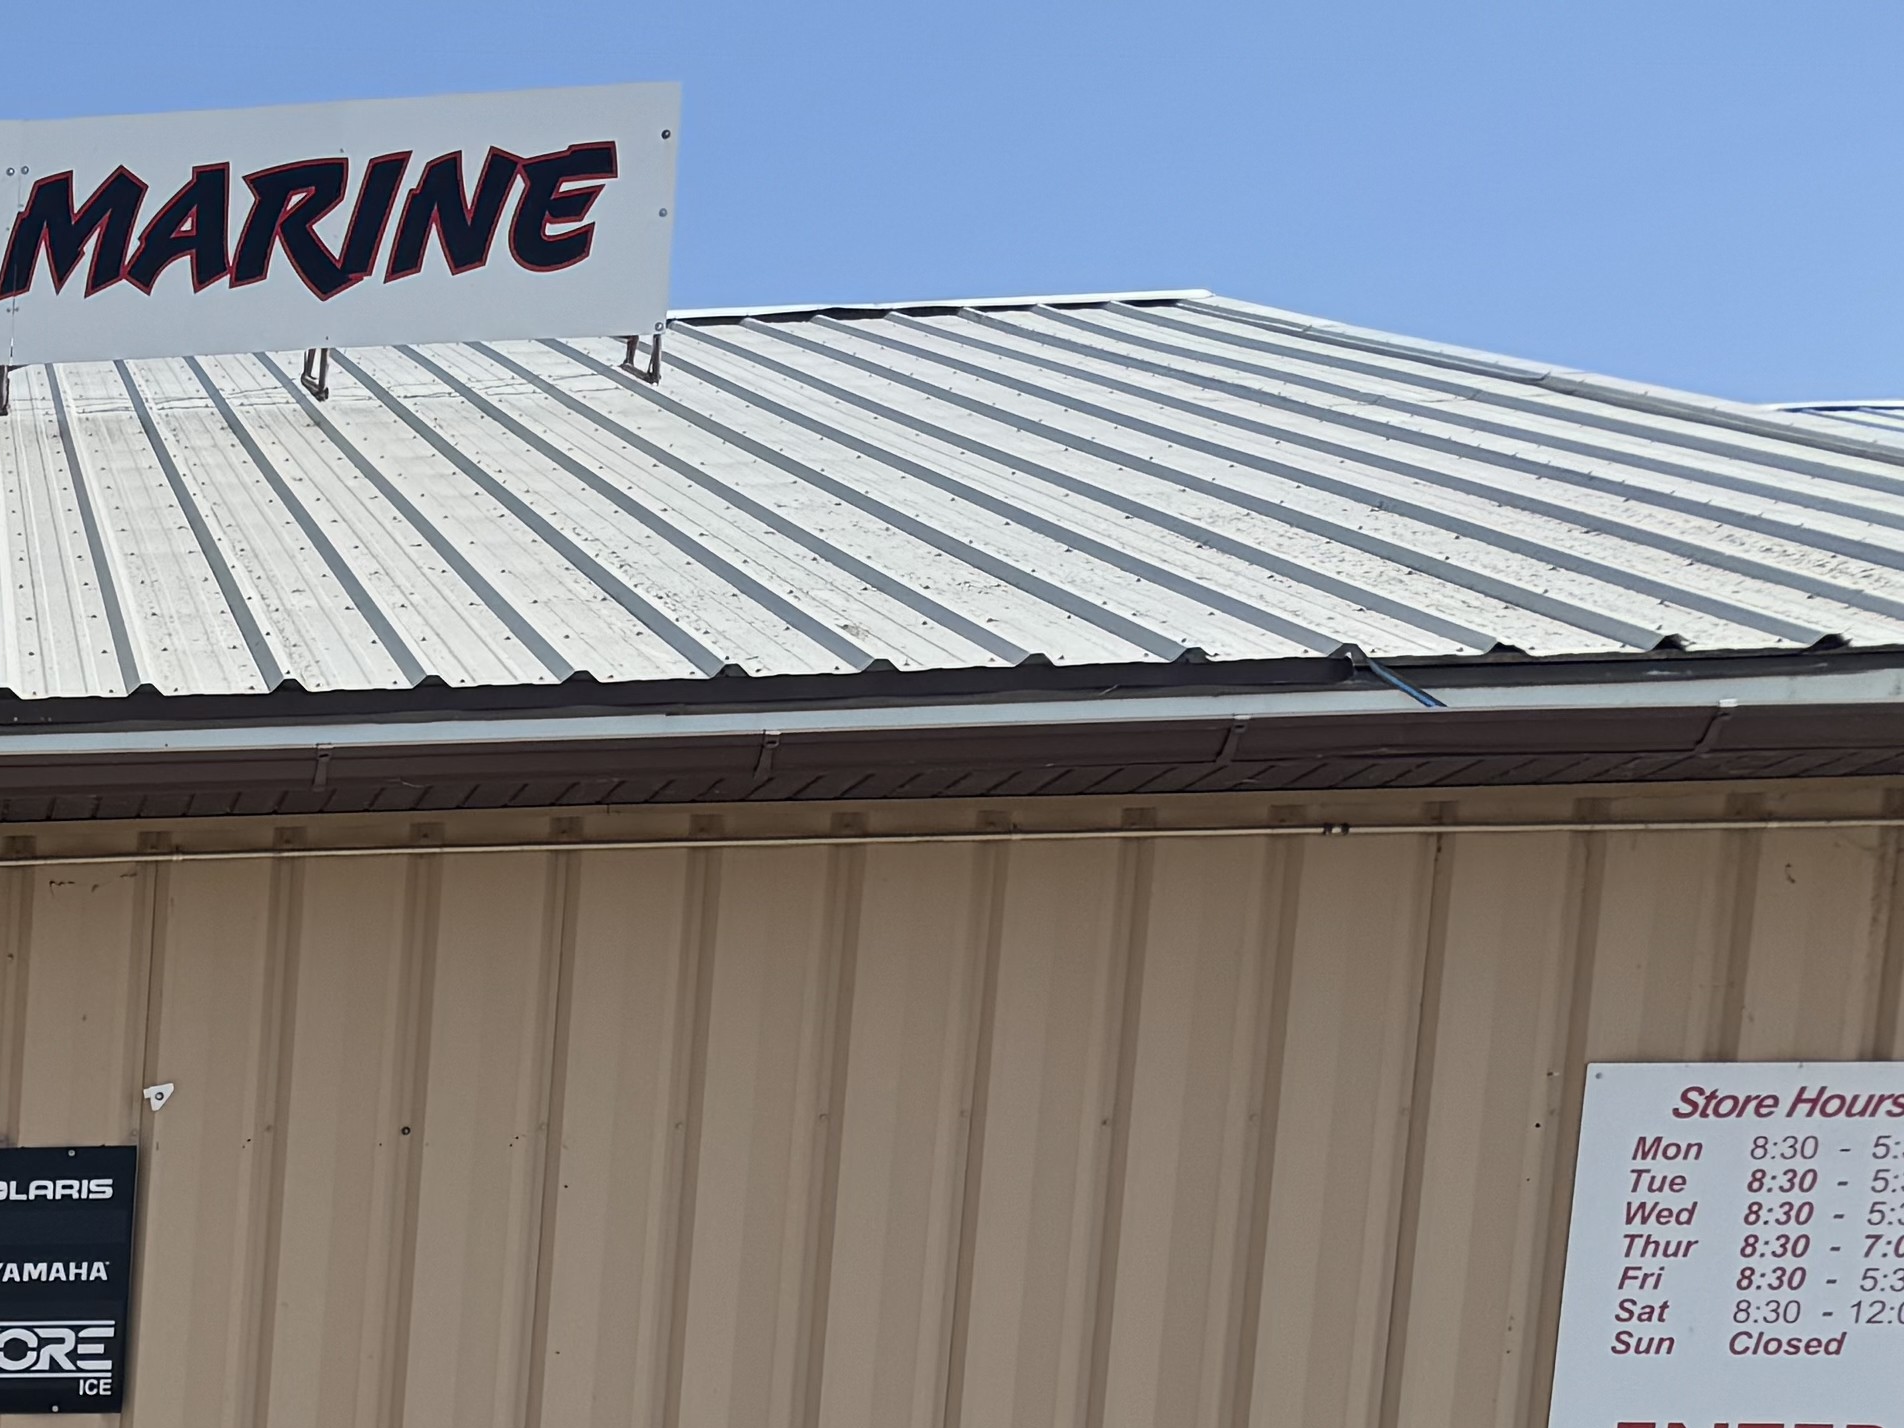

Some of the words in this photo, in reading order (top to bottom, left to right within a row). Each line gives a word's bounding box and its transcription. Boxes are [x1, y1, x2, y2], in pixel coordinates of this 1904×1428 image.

[1672, 1085, 1780, 1119] Store
[1785, 1085, 1904, 1118] Hours
[1631, 1136, 1704, 1161] Mon
[1749, 1135, 1820, 1160] 8:30
[1872, 1135, 1904, 1159] 5:
[1628, 1168, 1688, 1194] Tue
[1746, 1168, 1818, 1194] 8:30
[1871, 1168, 1904, 1194] 5:
[1623, 1201, 1698, 1226] Wed
[1742, 1201, 1815, 1226] 8:30
[1622, 1233, 1699, 1258] Thur
[1739, 1233, 1811, 1259] 8:30
[1617, 1266, 1666, 1291] Fri
[1735, 1266, 1807, 1291] 8:30
[1860, 1267, 1904, 1292] 5:3
[1614, 1298, 1670, 1324] Sat
[1731, 1299, 1802, 1324] 8:30
[1610, 1331, 1676, 1356] Sun
[1728, 1331, 1848, 1356] Closed
[78, 1378, 113, 1396] ICE
